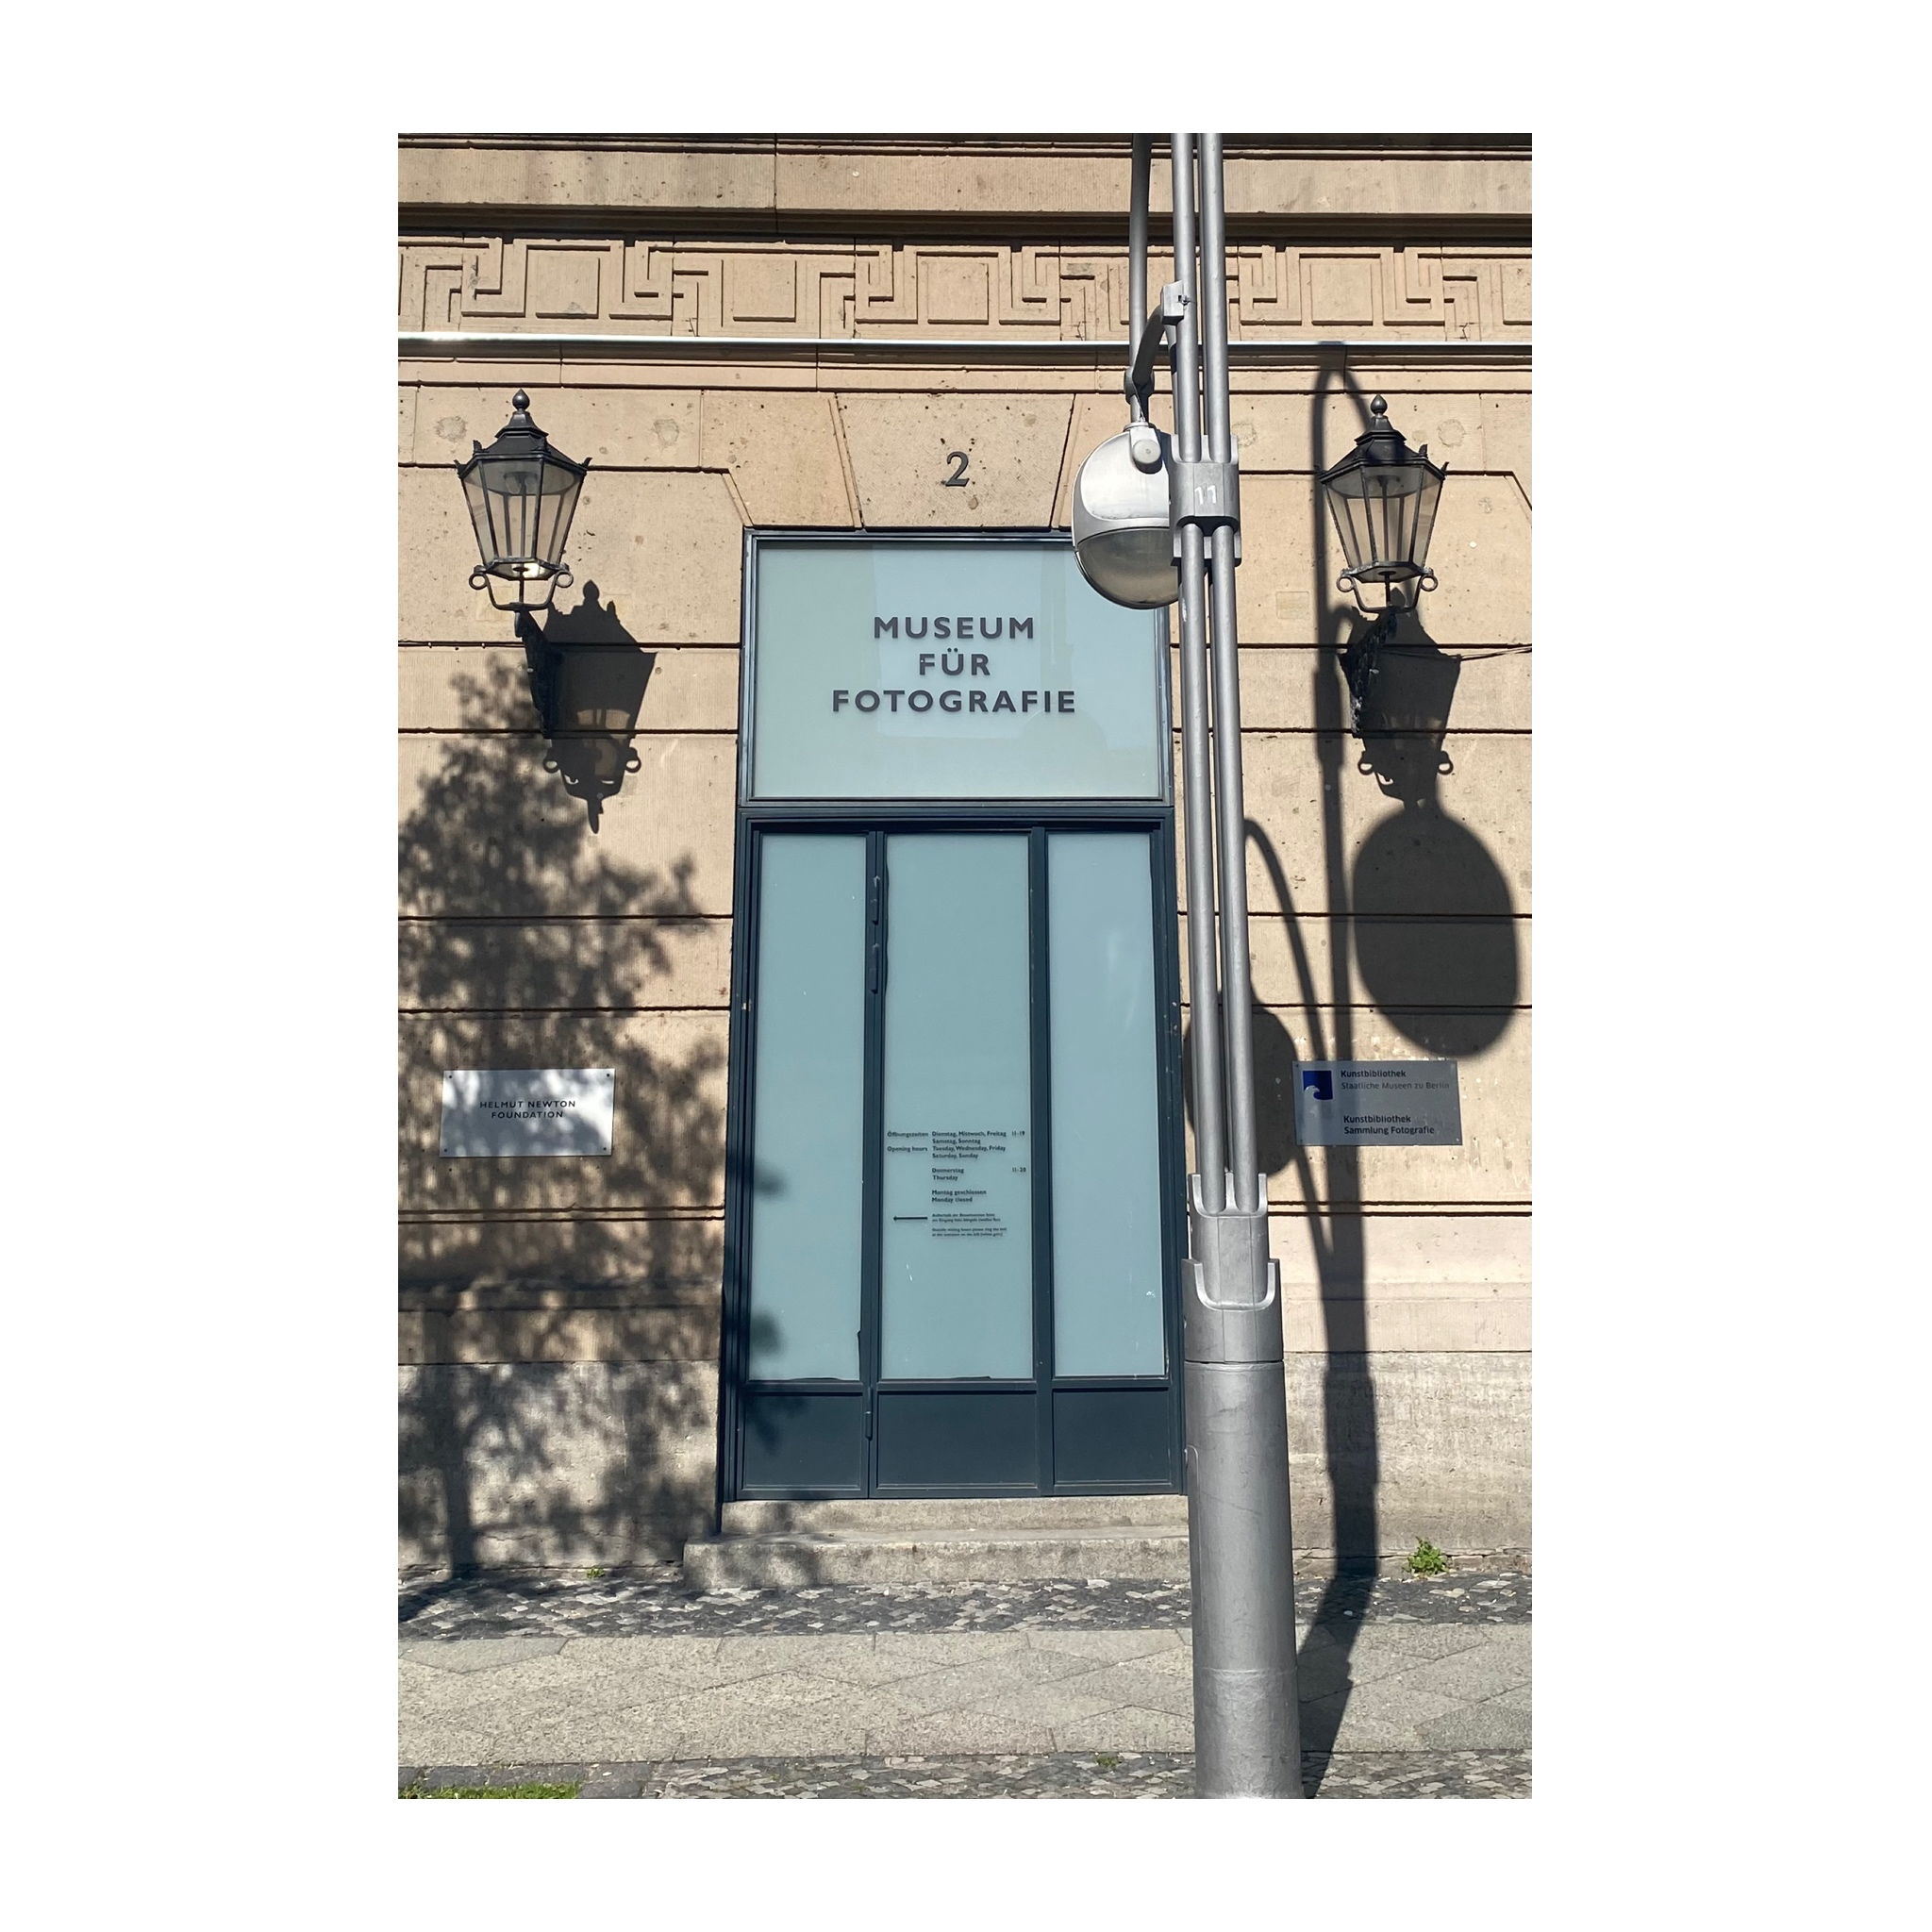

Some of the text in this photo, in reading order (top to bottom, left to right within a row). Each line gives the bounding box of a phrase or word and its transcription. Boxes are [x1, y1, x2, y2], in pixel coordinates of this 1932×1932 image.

[945, 451, 970, 487] 2
[1194, 485, 1216, 505] 11
[874, 617, 1033, 639] MUSEUM
[919, 647, 991, 675] FÜR
[833, 690, 1075, 713] FOTOGRAFIE
[1344, 1126, 1435, 1135] Sammlung Fotografie
